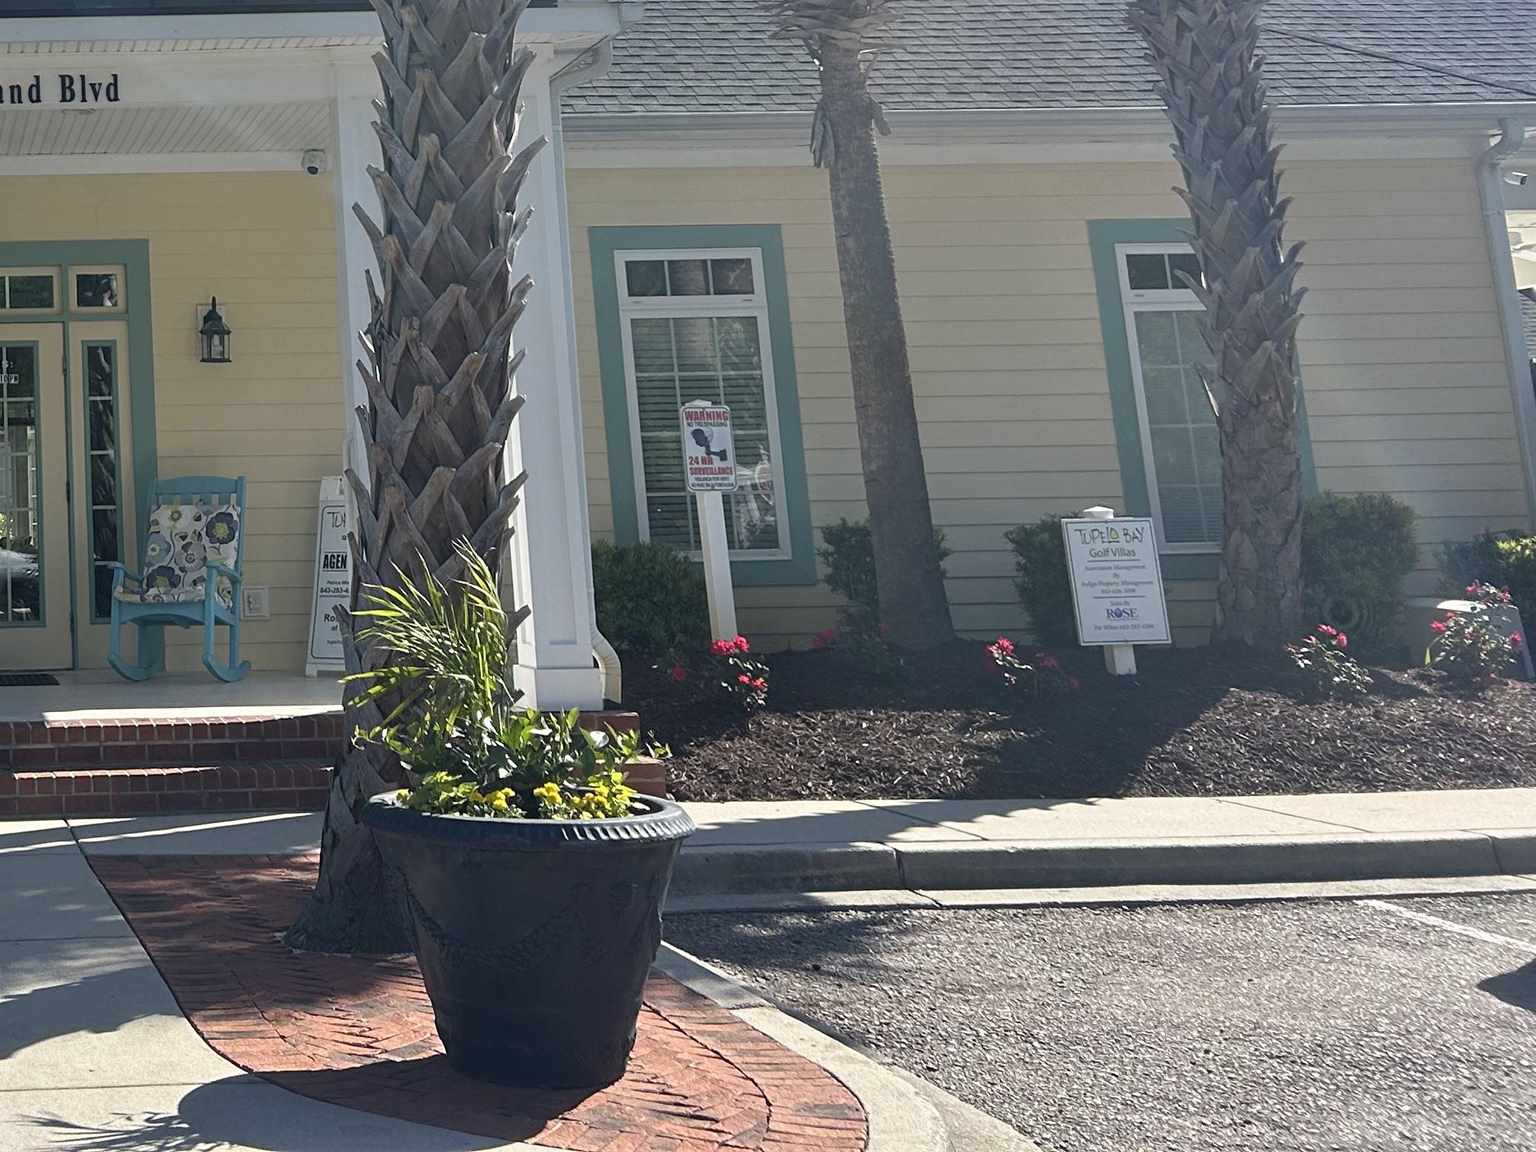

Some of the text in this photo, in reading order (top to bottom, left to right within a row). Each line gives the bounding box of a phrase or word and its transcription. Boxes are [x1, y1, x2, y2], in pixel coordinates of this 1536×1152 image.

[58, 73, 120, 103] Blvd
[685, 410, 729, 421] WARNING
[688, 456, 699, 465] 24
[1074, 527, 1145, 545] TUPELO BAY
[1089, 547, 1137, 559] Golf Villas
[1106, 608, 1138, 618] ROSE
